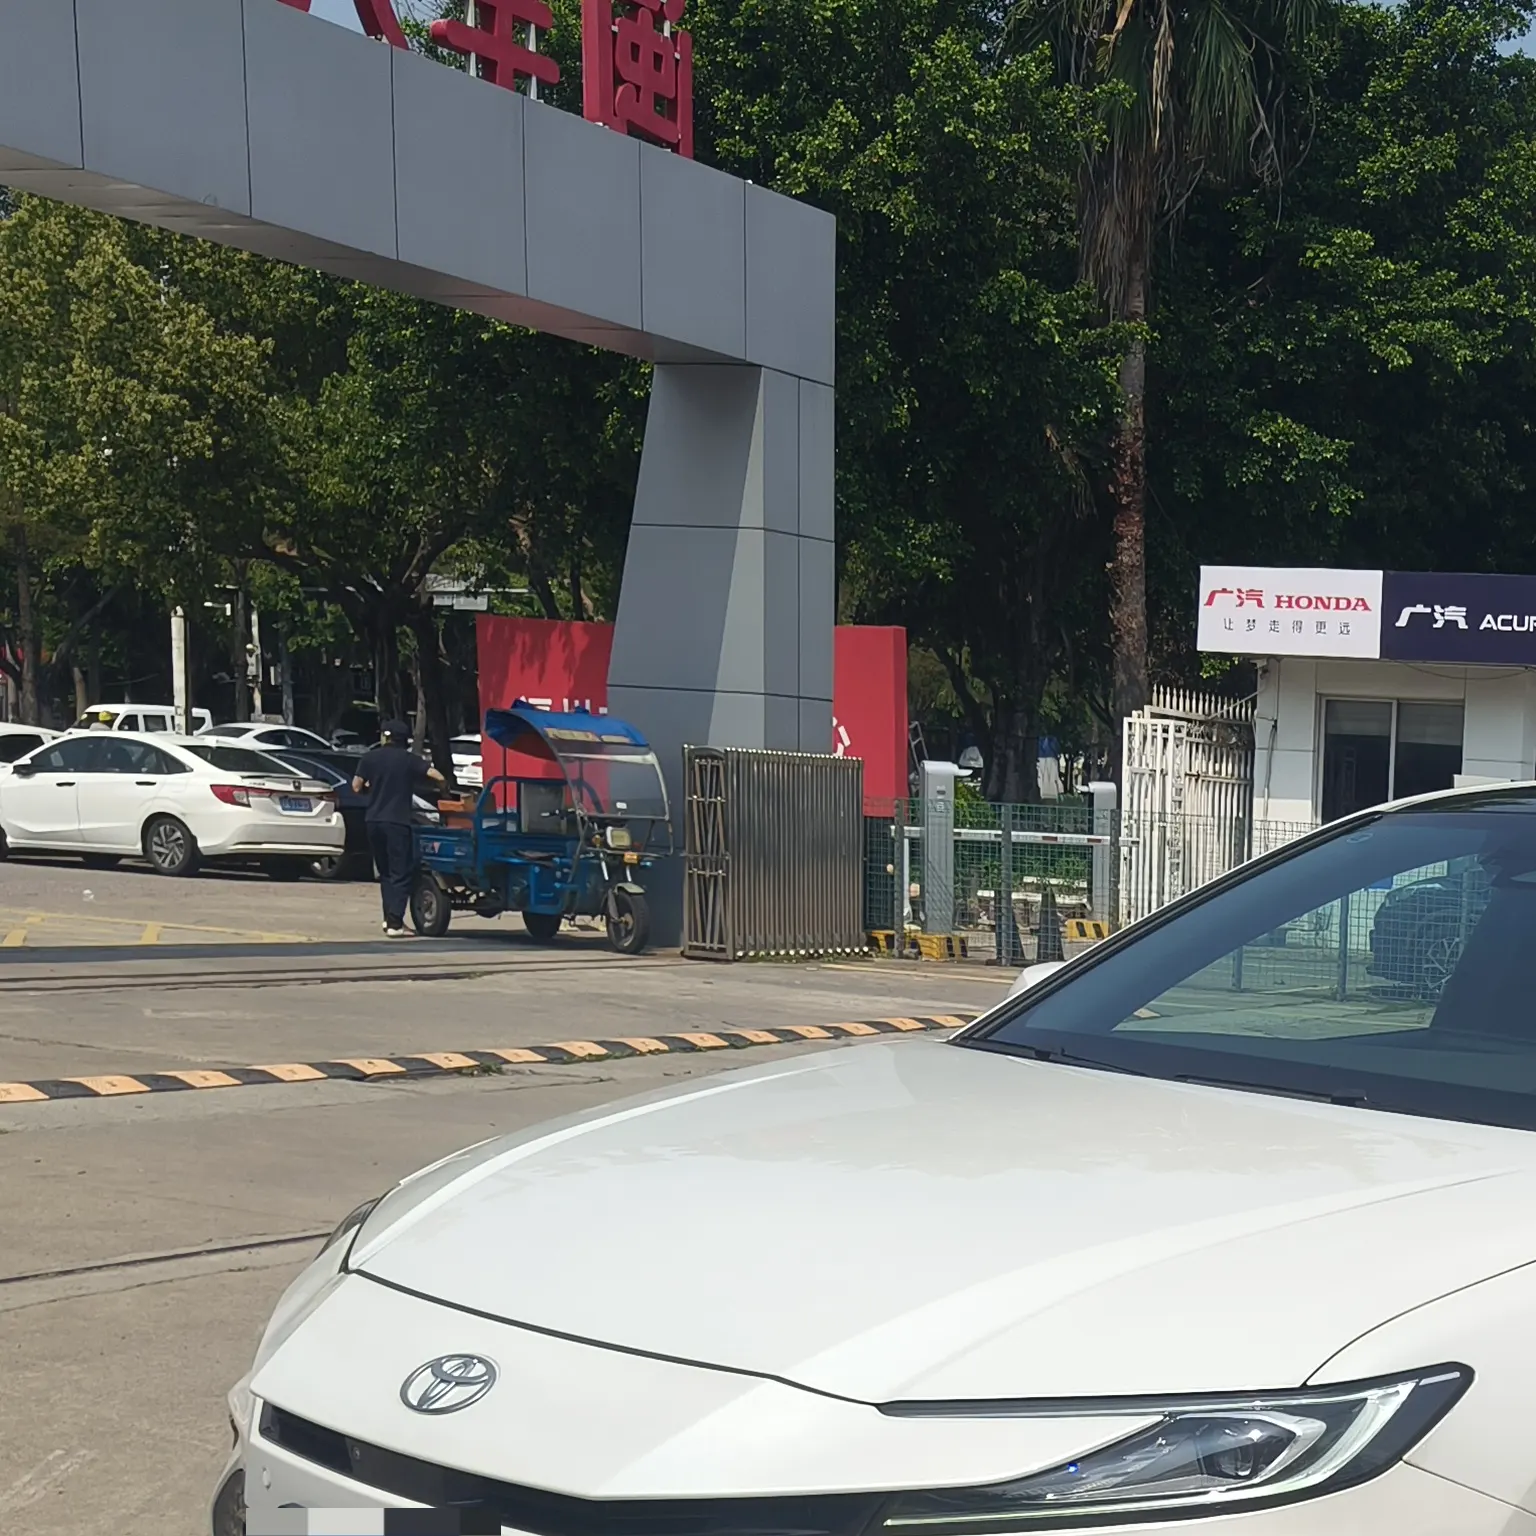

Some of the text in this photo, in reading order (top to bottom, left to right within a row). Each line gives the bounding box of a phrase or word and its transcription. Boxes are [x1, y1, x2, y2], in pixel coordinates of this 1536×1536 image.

[1204, 588, 1372, 612] 广汽 HONDA
[1223, 617, 1351, 636] 让梦走得更远
[1395, 604, 1468, 629] 广汽
